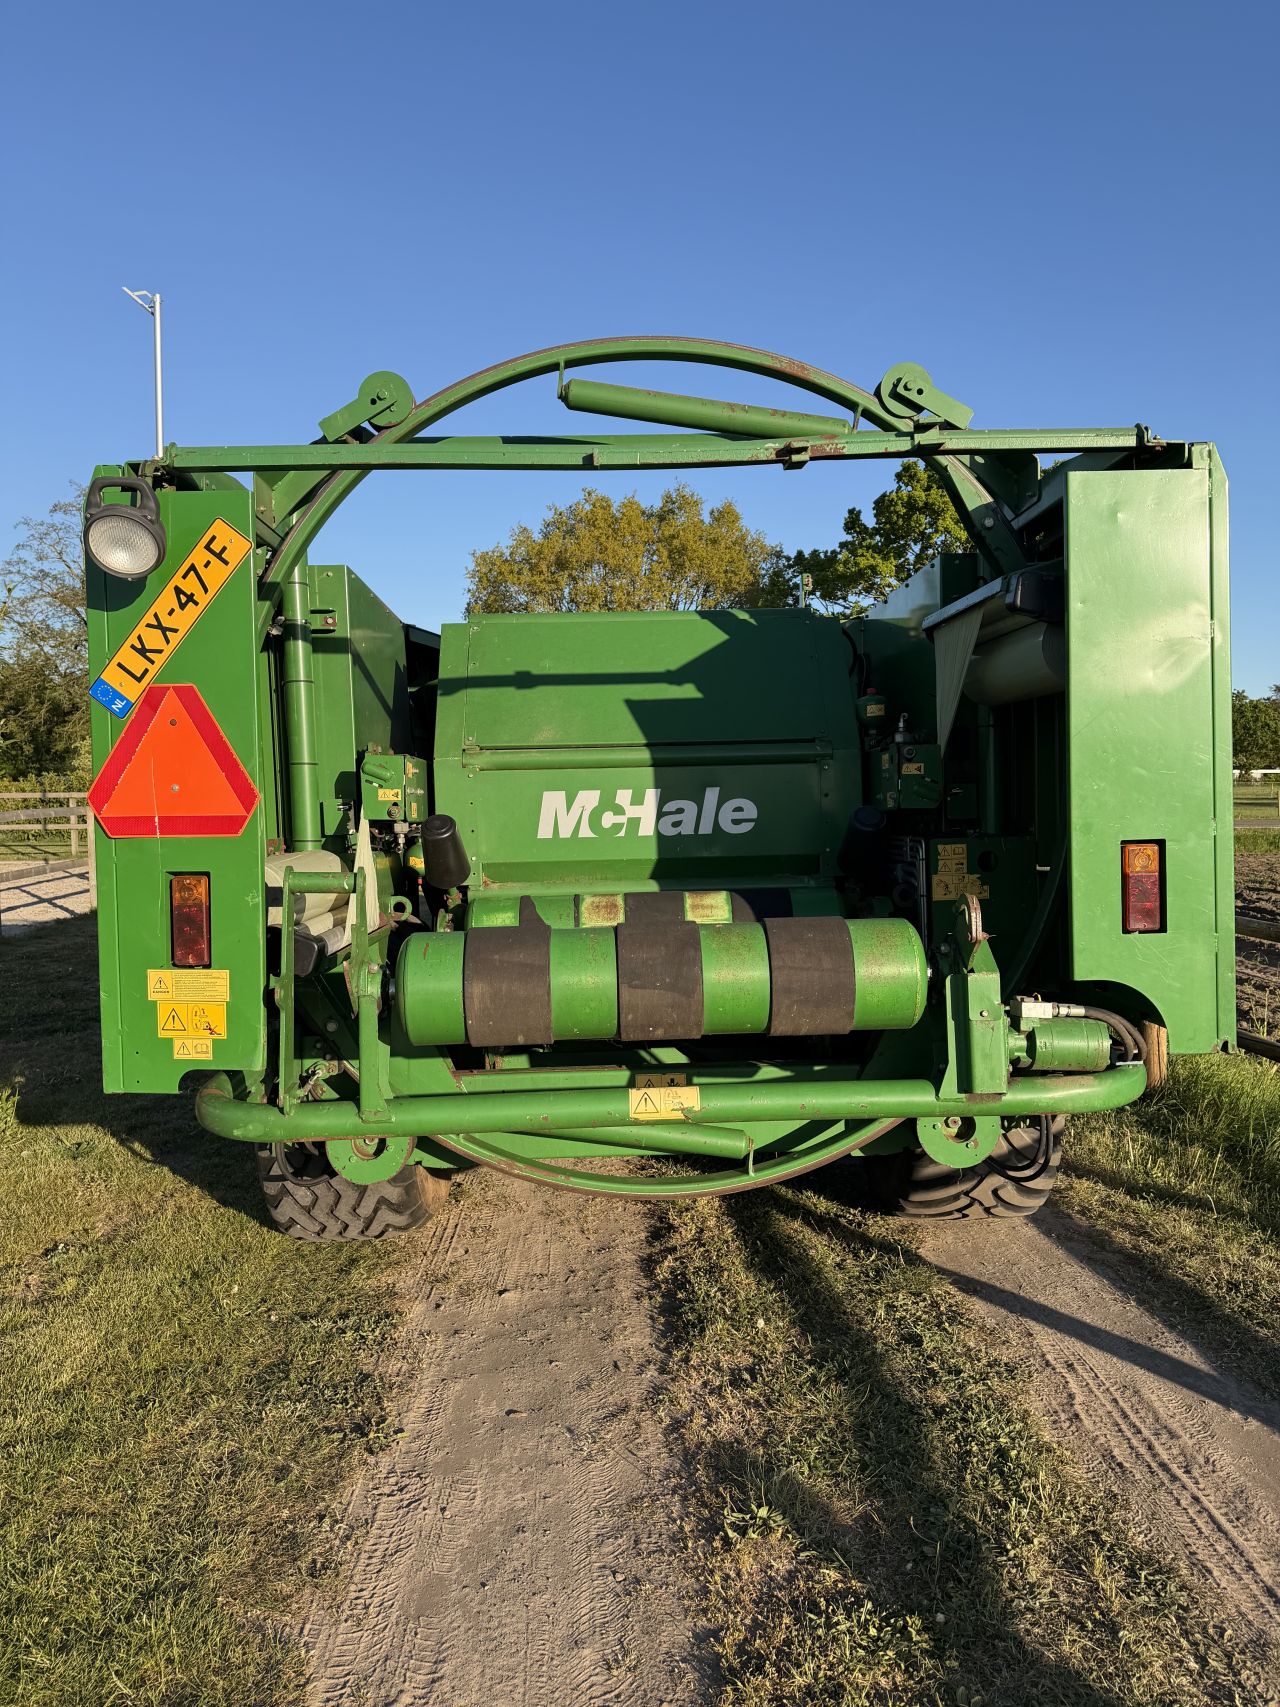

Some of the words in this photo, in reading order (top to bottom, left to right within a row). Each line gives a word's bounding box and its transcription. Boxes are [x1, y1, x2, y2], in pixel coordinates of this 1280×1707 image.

[116, 534, 230, 684] LKX-47-F
[111, 699, 127, 712] NL
[536, 786, 758, 839] McHale
